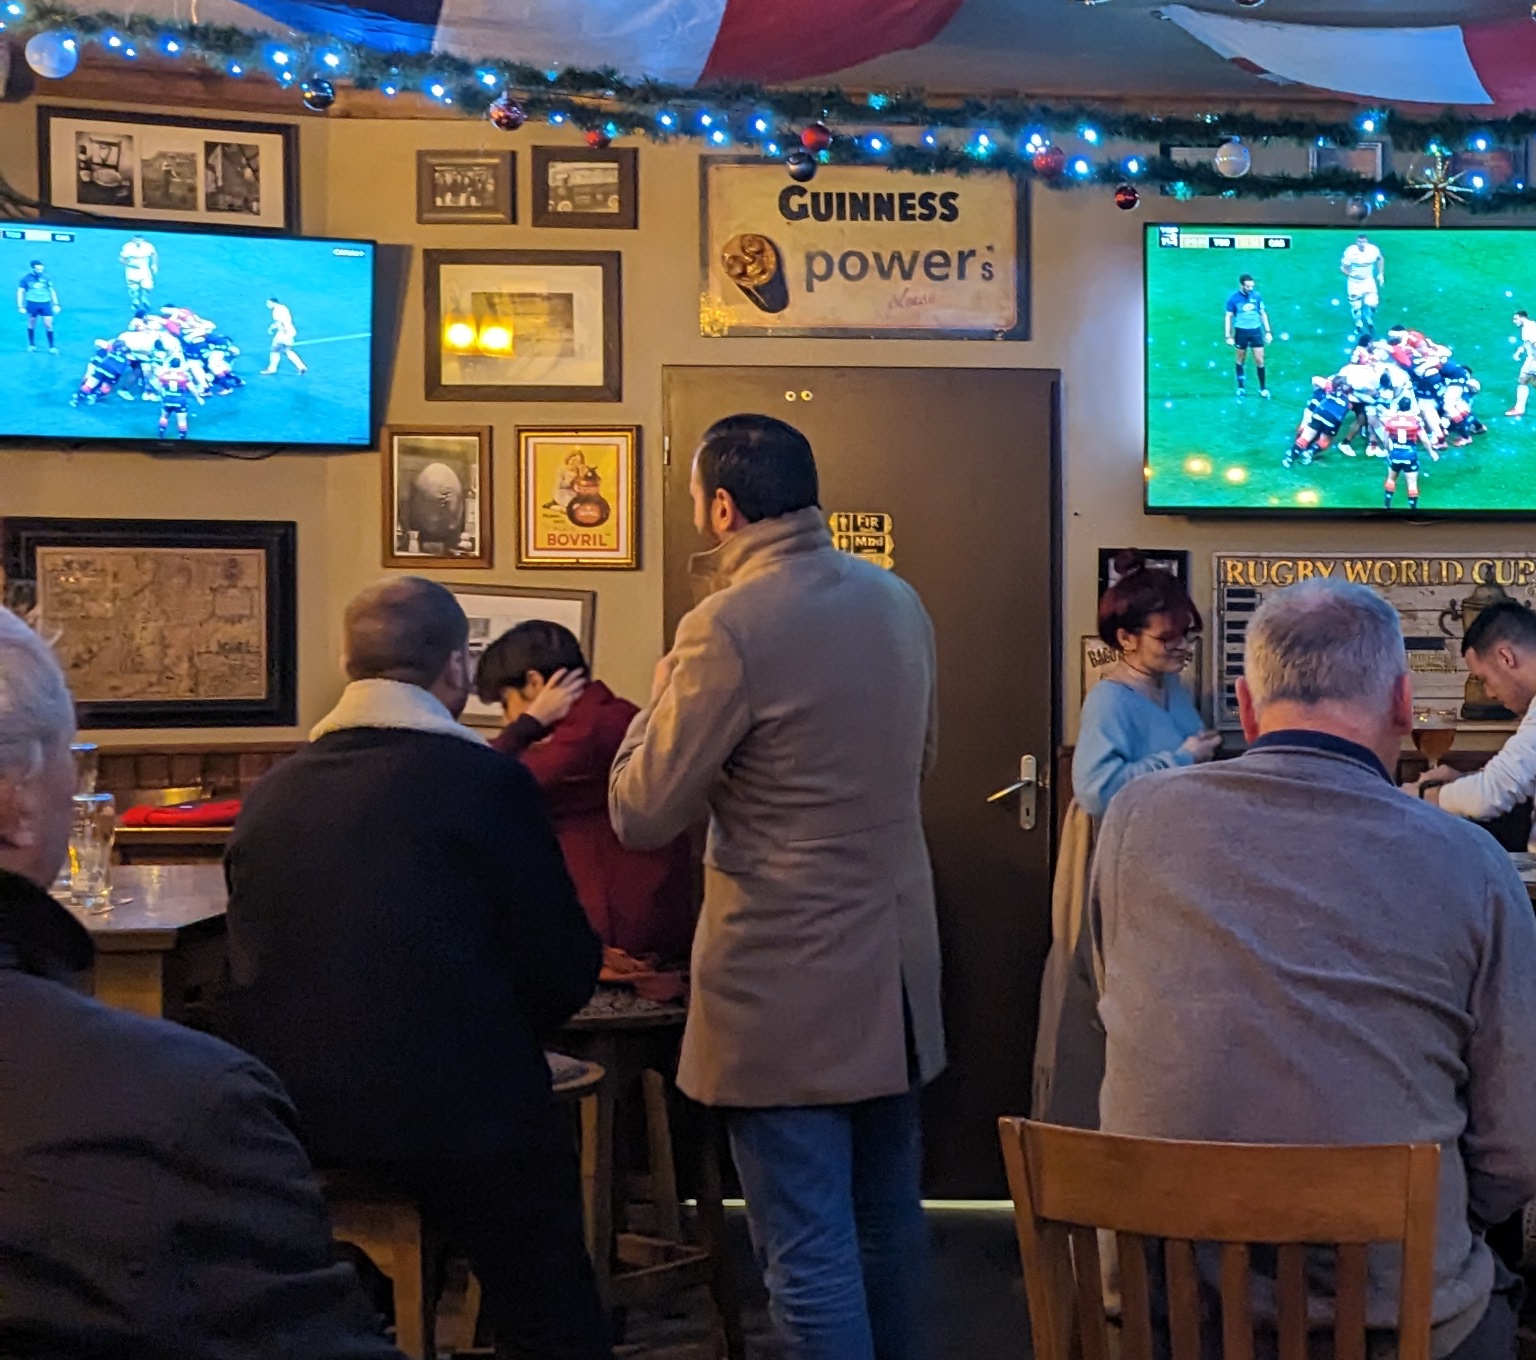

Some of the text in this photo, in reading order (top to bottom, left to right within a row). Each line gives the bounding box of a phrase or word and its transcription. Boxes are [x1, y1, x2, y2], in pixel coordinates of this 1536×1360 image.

[778, 185, 960, 222] GUINNESS
[546, 533, 608, 547] BOVRIL
[1225, 558, 1335, 586] RUGBY
[1342, 559, 1465, 586] WORLD
